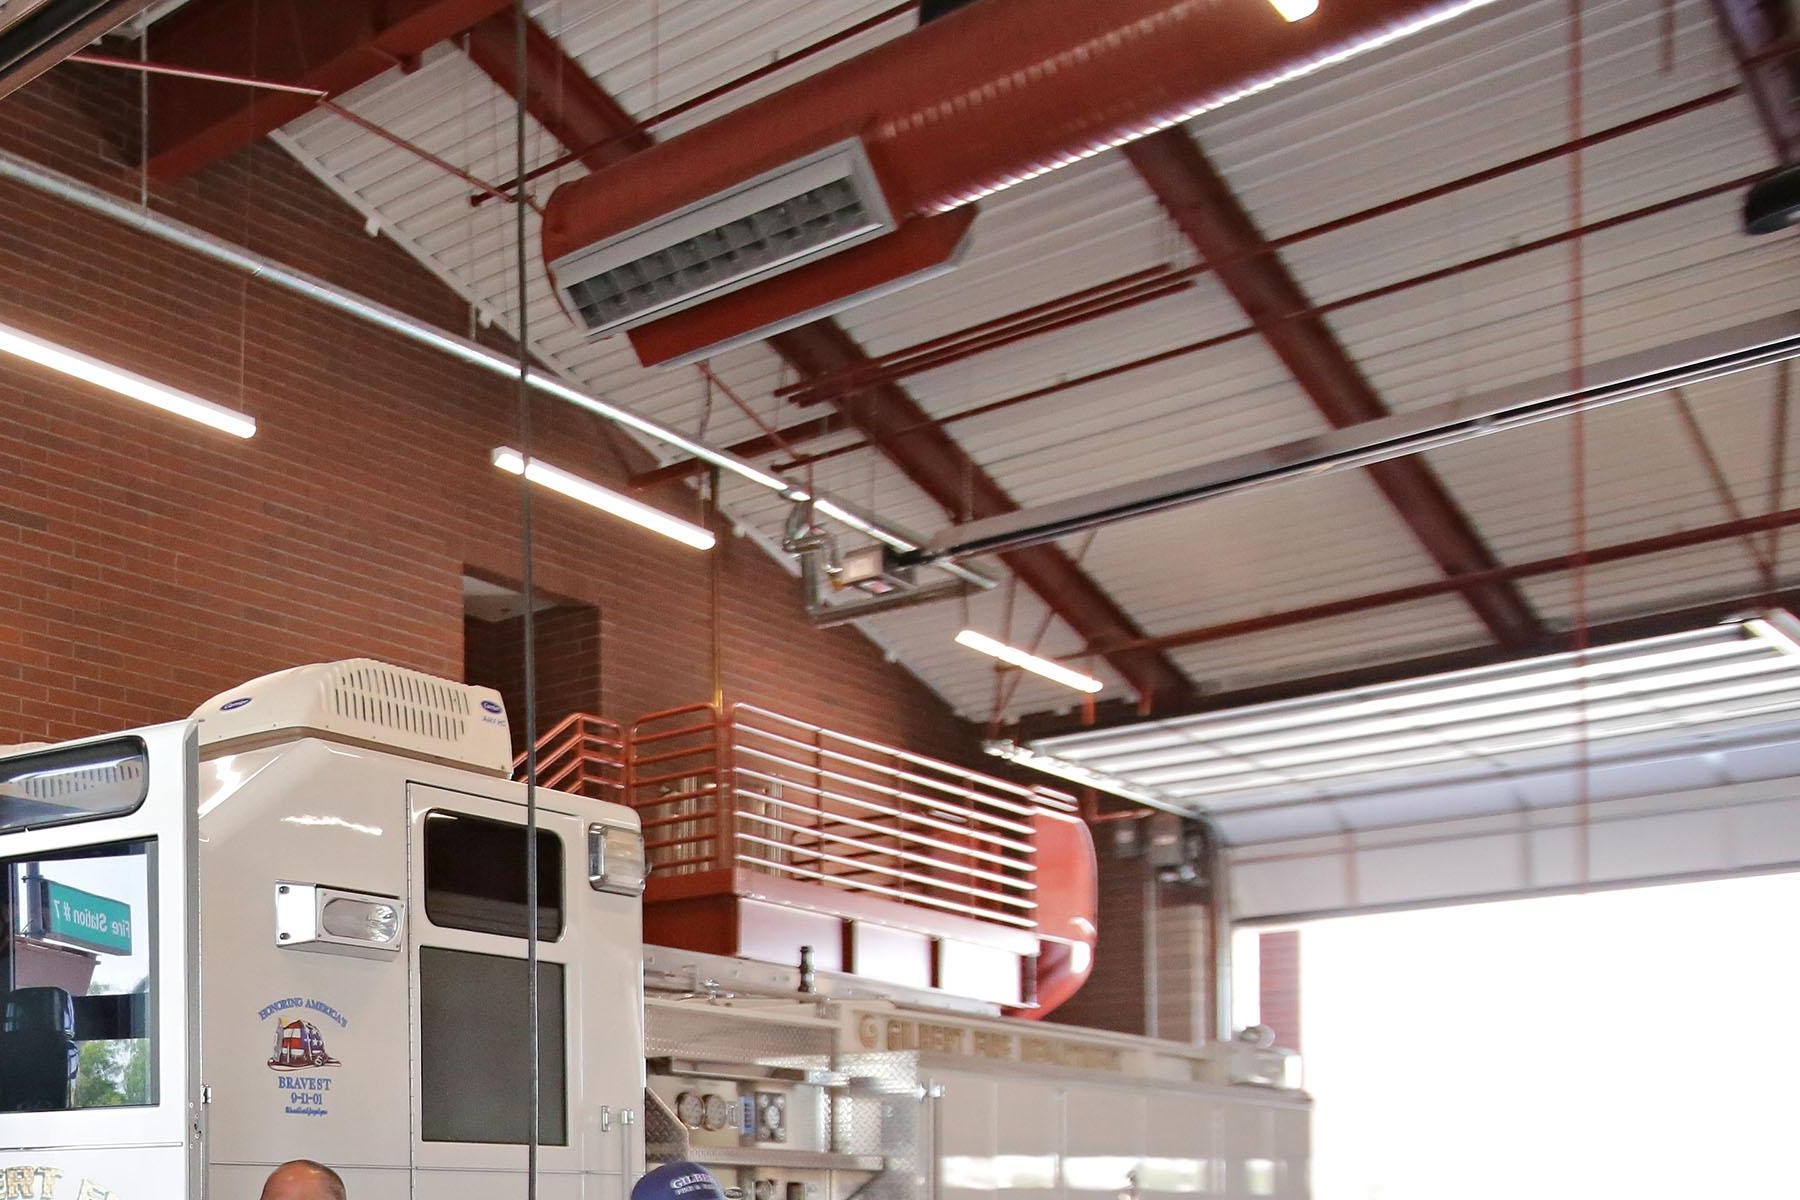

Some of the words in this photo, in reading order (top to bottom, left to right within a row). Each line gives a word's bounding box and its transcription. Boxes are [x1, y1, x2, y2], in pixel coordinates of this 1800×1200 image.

[258, 997, 303, 1021] HONORING
[305, 998, 348, 1028] AMERICA'S
[278, 1076, 332, 1091] BRAVEST
[291, 1092, 323, 1105] 9-11-01
